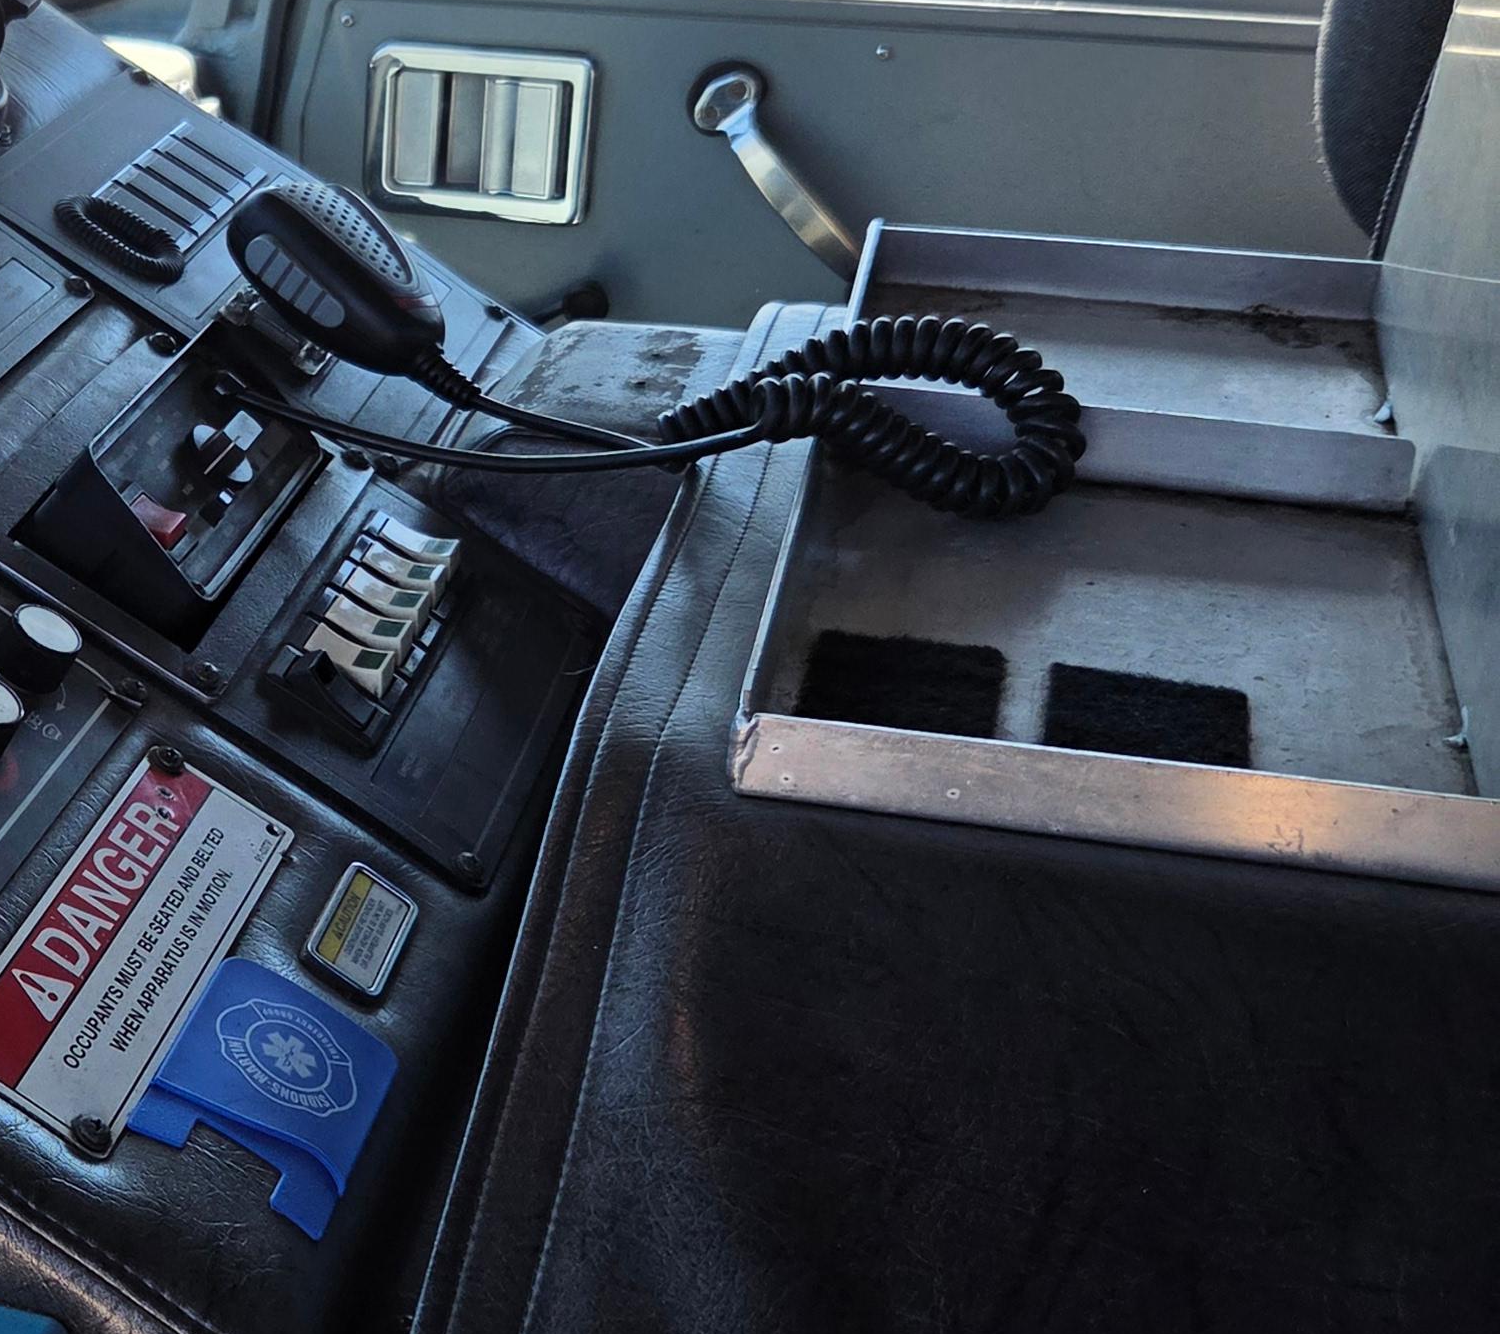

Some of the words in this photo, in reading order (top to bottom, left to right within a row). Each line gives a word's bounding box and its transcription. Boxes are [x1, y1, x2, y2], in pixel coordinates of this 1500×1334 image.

[31, 801, 181, 979] DANGER
[194, 869, 234, 913] MOTION.
[336, 891, 361, 933] CAUTION
[181, 919, 198, 942] IS
[192, 904, 208, 928] IN
[63, 983, 125, 1070] OCCUPANTS
[114, 948, 148, 989] MUST
[137, 929, 159, 956] BE
[148, 888, 185, 936] SEATED
[176, 865, 201, 894] AND
[190, 826, 226, 874] BELTED
[139, 936, 191, 1014] APPARATUS
[108, 1008, 146, 1054] WHEN
